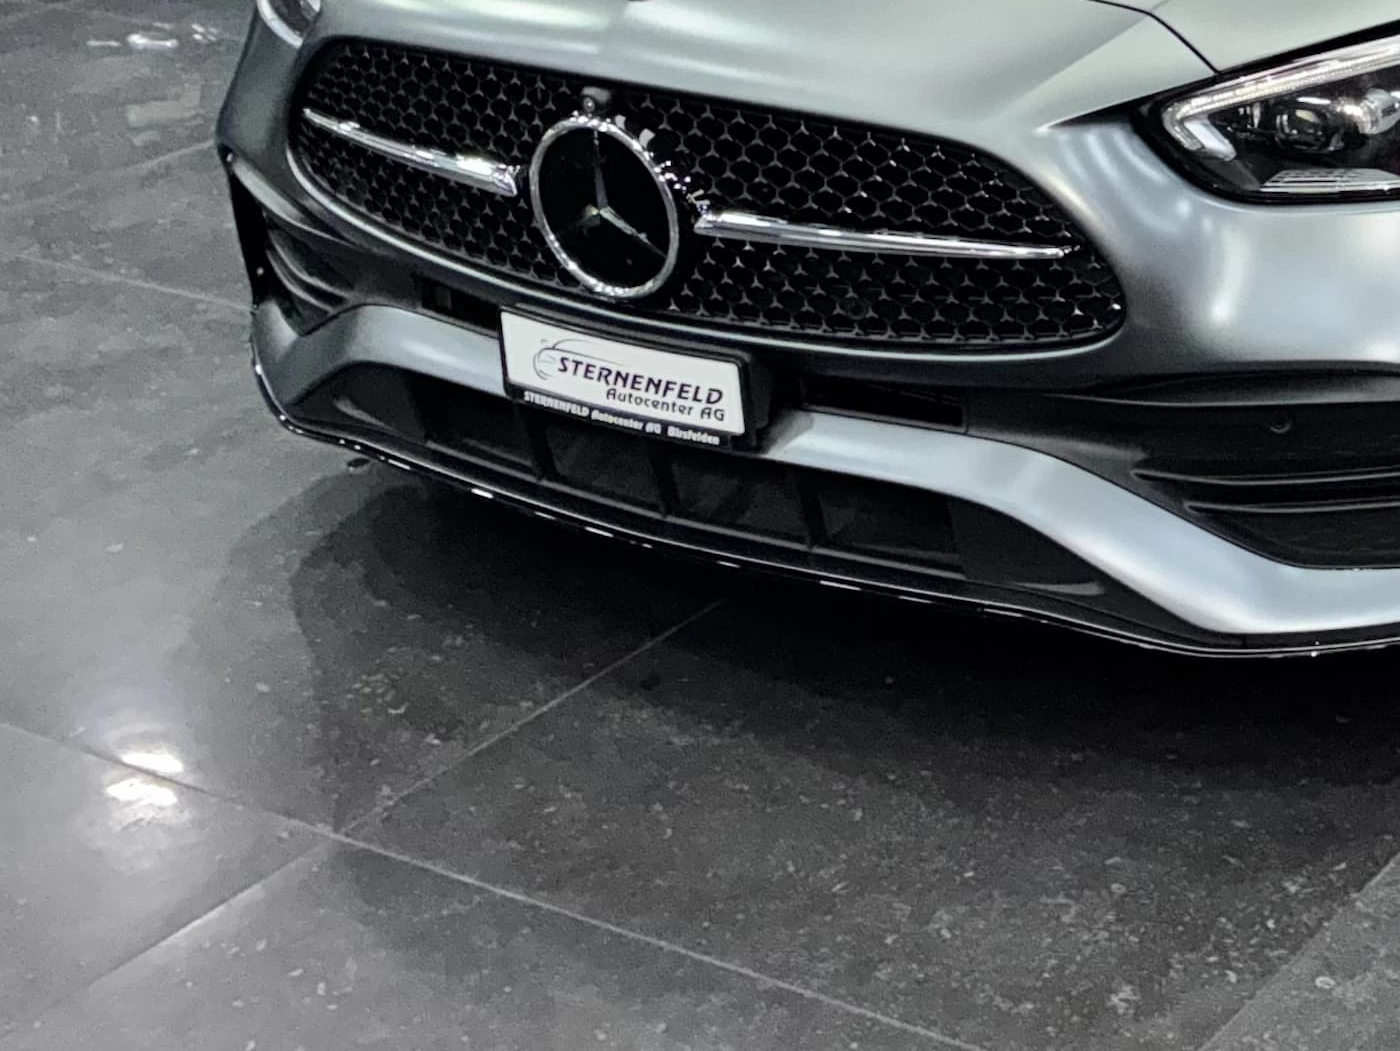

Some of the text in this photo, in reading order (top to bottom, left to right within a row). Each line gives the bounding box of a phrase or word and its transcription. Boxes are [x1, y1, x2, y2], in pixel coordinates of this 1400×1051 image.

[557, 356, 724, 405] STERNENFELD
[606, 388, 725, 422] Autocenter AG
